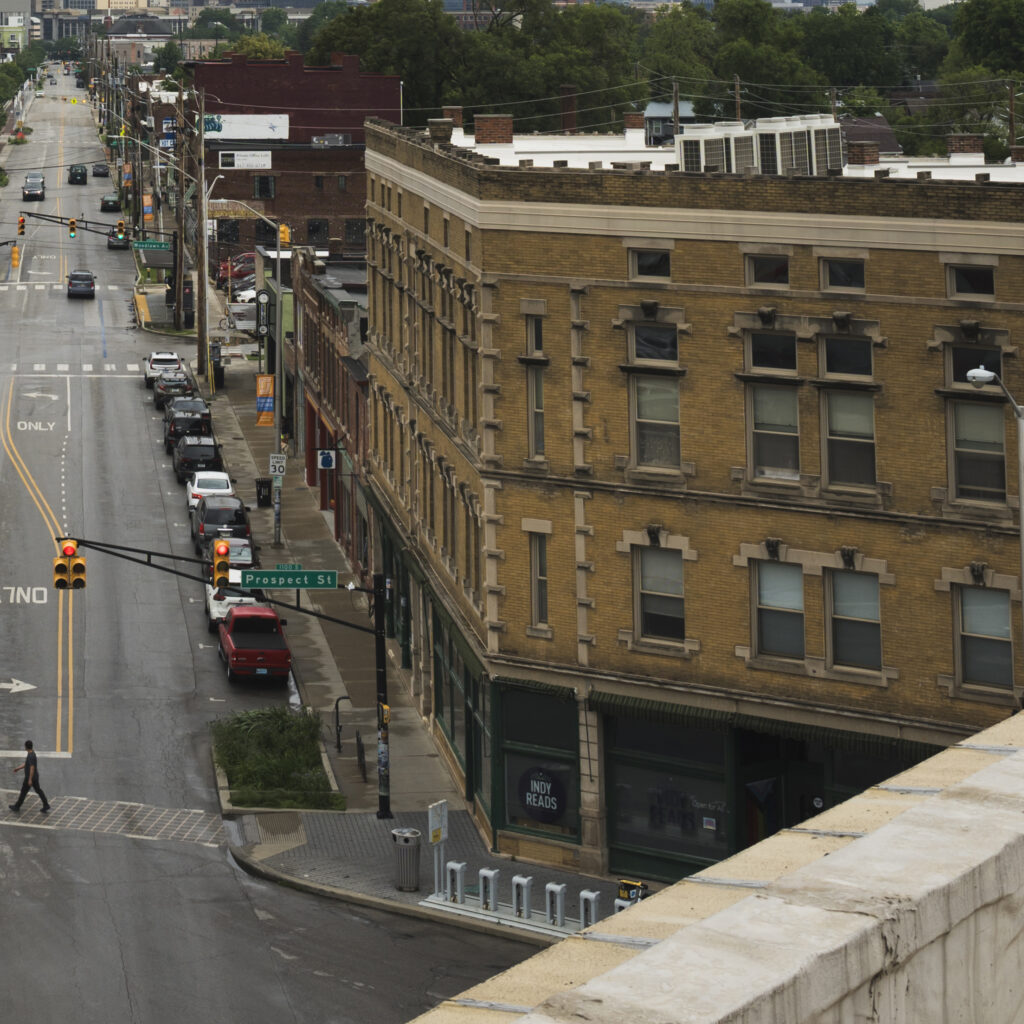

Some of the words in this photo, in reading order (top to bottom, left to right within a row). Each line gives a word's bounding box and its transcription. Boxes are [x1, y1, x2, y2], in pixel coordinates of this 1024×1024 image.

[17, 420, 56, 431] ONLY
[270, 464, 285, 474] 30
[245, 573, 309, 586] Prospect
[317, 574, 332, 585] St
[530, 779, 552, 795] INDY
[526, 791, 558, 810] READS
